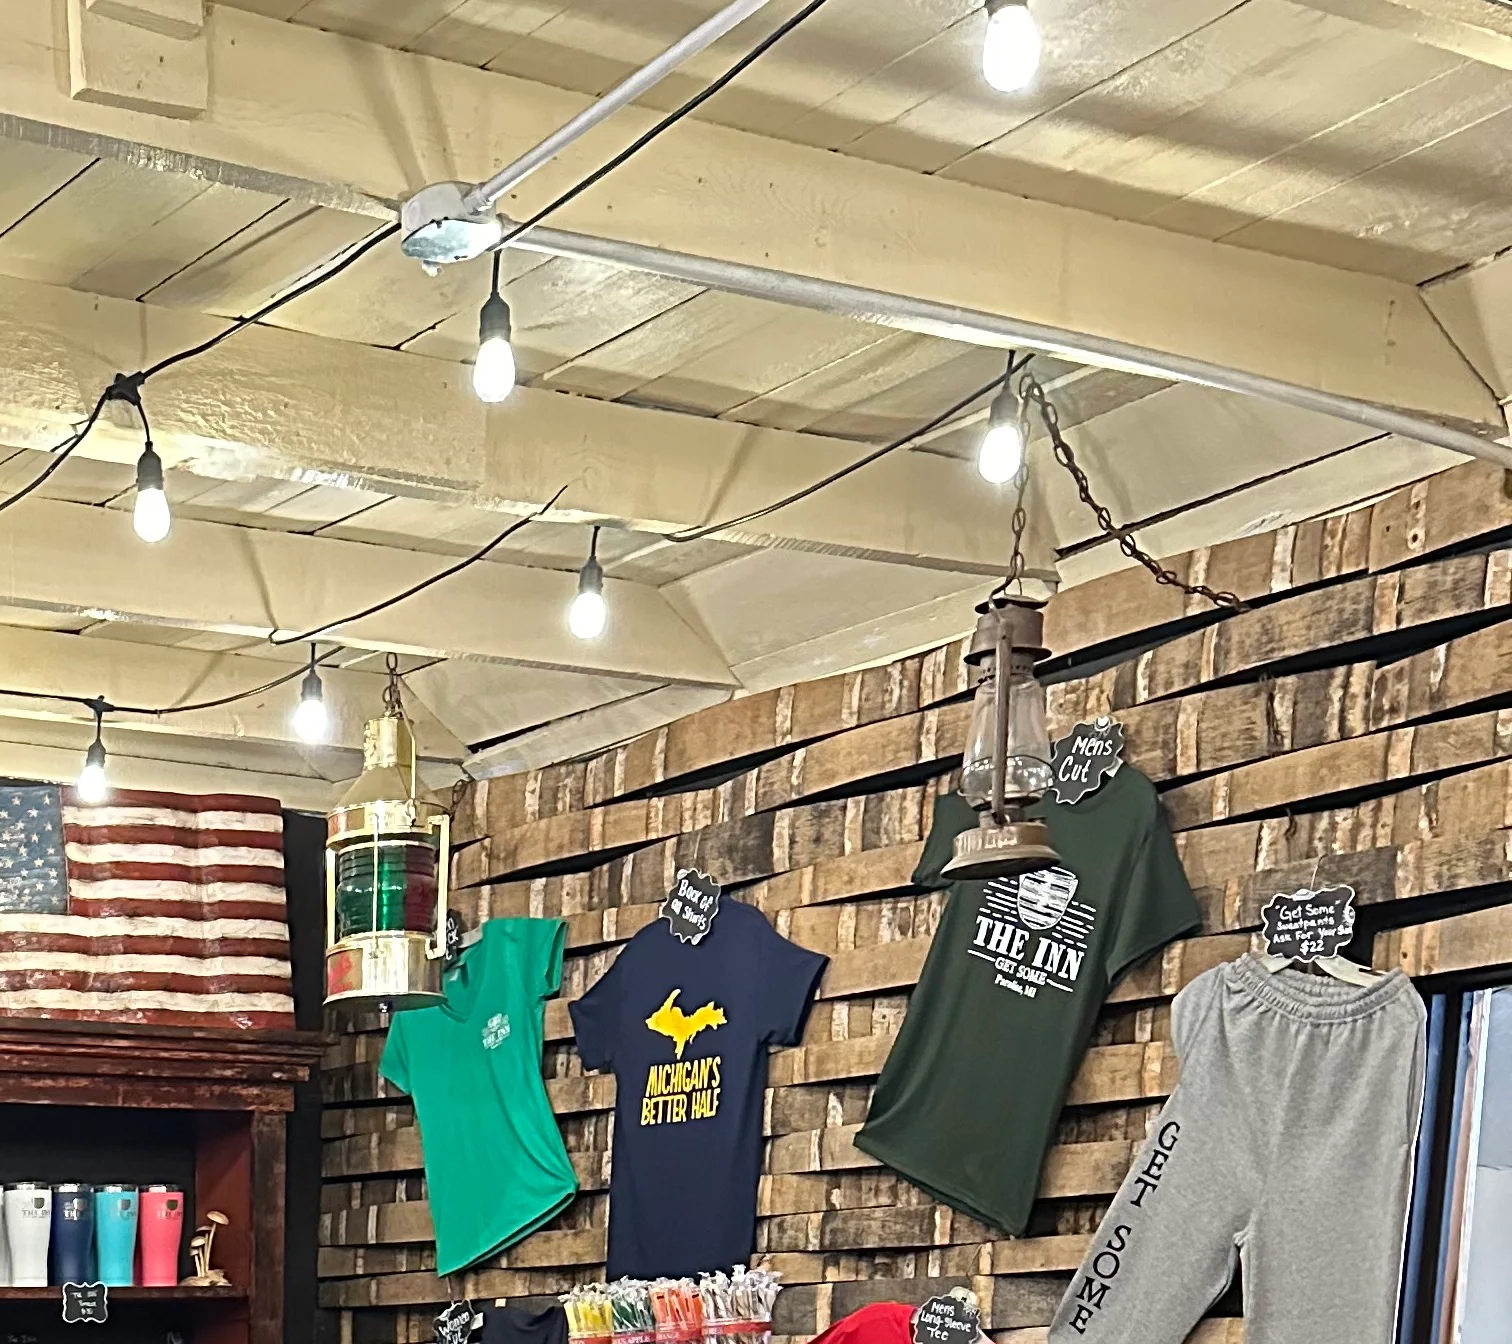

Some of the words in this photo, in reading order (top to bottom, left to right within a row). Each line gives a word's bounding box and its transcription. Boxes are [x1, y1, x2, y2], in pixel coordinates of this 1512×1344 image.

[1072, 736, 1112, 756] Mens
[1058, 756, 1091, 782] Cut
[1273, 934, 1292, 944] Ask
[1296, 931, 1314, 940] For
[1277, 917, 1335, 932] Sweatpants
[973, 915, 1029, 961] THE
[1031, 937, 1085, 981] INN
[1300, 940, 1324, 955] $22
[995, 957, 1017, 974] GET
[1018, 964, 1048, 986] SOME
[646, 1056, 721, 1097] MICHIGAN'S
[641, 1095, 687, 1126] BETTER
[691, 1088, 721, 1120] HALF
[1130, 1121, 1181, 1208] GET
[1069, 1225, 1132, 1335] SOME
[931, 1301, 955, 1317] Mens
